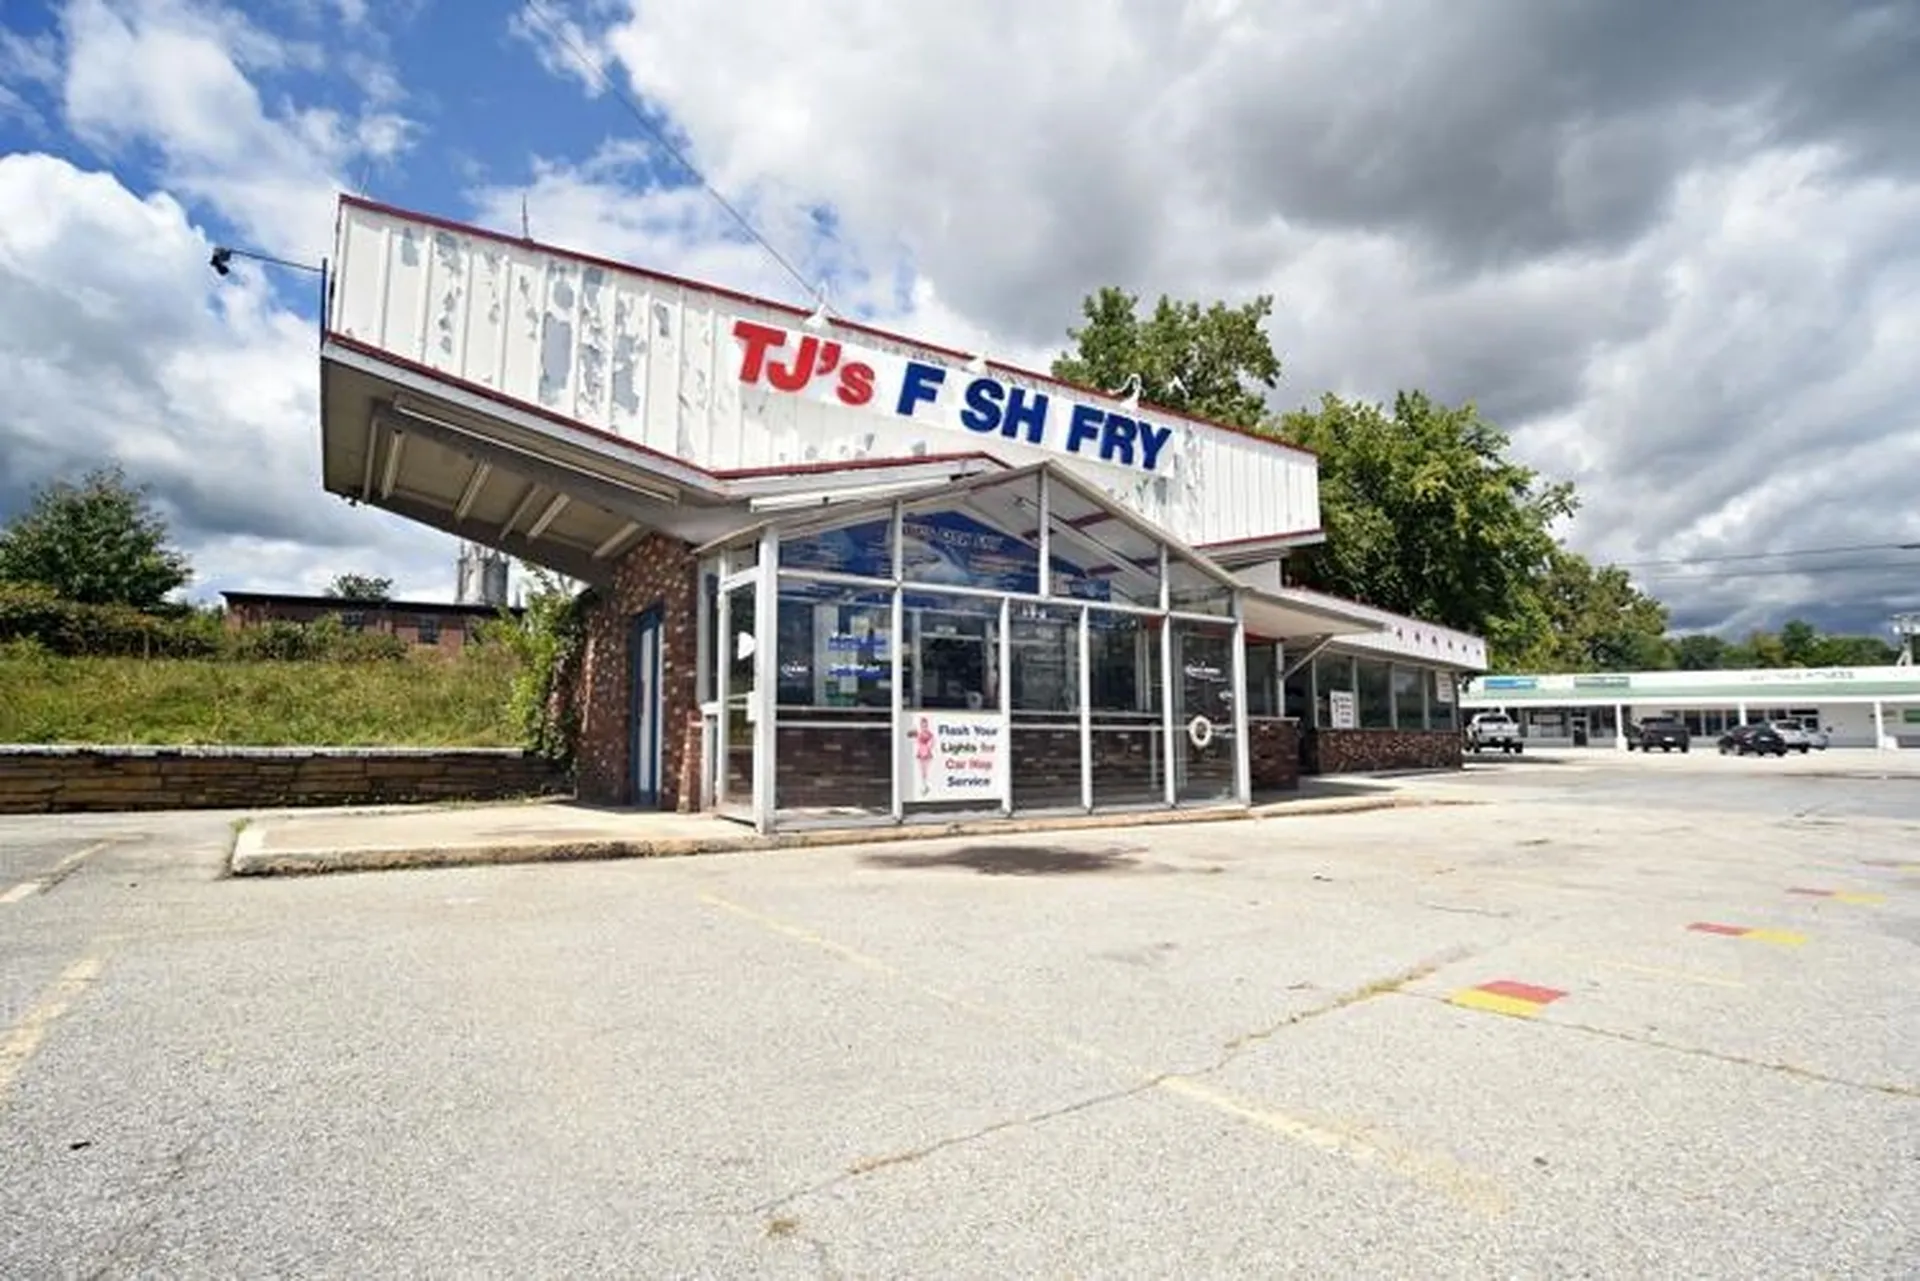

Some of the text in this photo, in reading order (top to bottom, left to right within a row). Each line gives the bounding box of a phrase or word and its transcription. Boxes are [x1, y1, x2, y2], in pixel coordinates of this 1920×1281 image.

[733, 319, 875, 407] TJ's
[1066, 403, 1173, 471] FRY
[938, 724, 998, 736] Flash Your
[941, 742, 996, 755] Lights for
[945, 758, 966, 769] Car
[947, 776, 991, 787] Service
